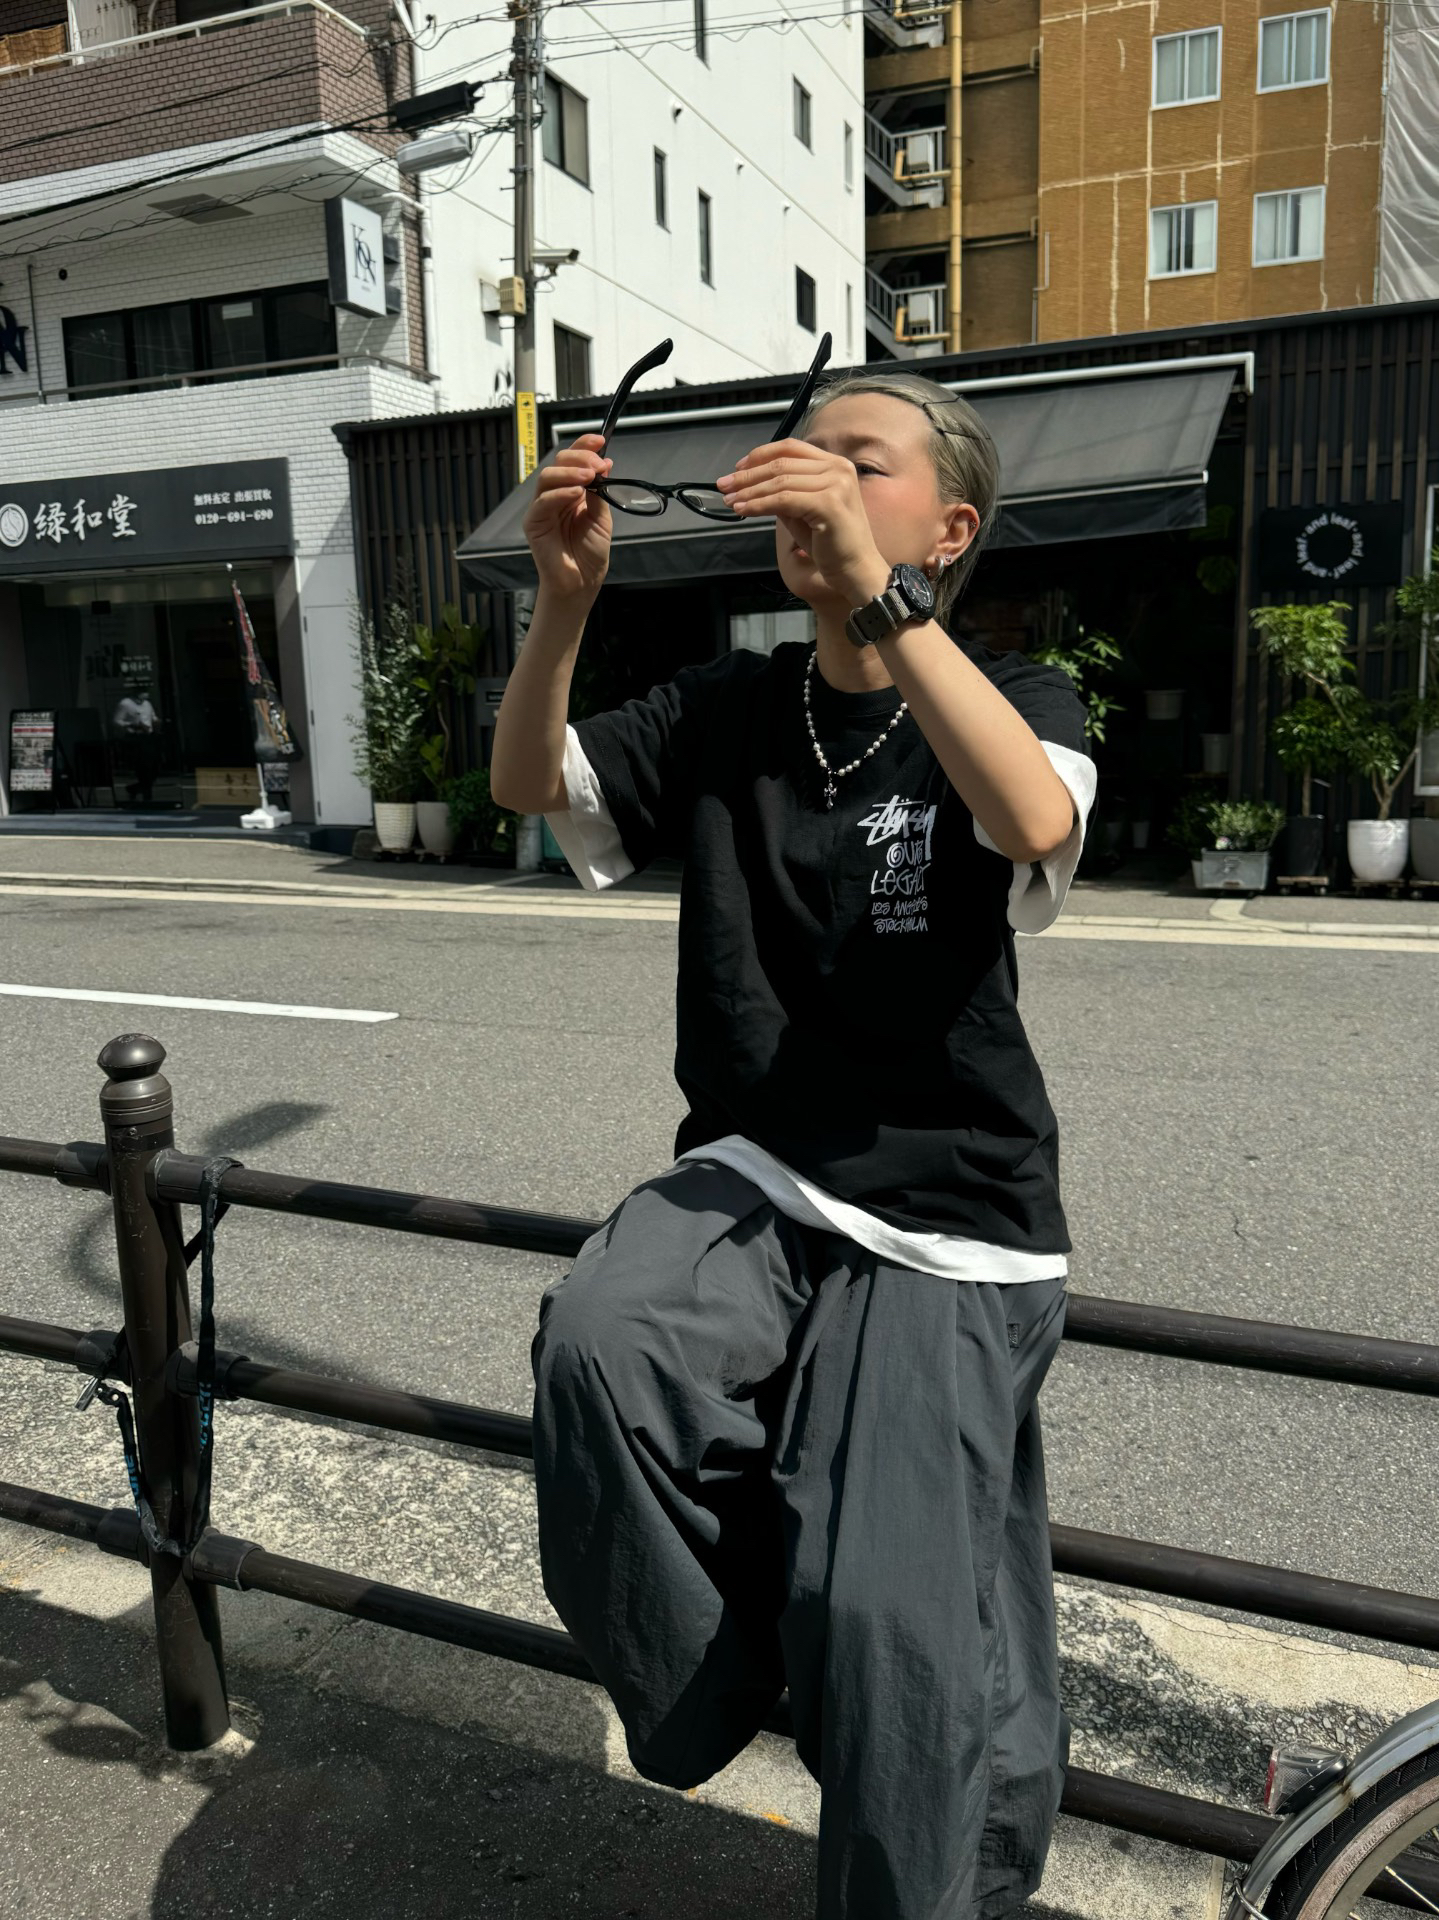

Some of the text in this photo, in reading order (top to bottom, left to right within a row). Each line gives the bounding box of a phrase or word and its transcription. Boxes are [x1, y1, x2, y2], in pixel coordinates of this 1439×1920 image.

[33, 494, 138, 544] 緑和堂
[1305, 512, 1329, 534] and
[1330, 512, 1358, 530] leaf
[1296, 536, 1308, 564] leaf
[1352, 533, 1364, 557] and
[871, 901, 891, 915] LOS
